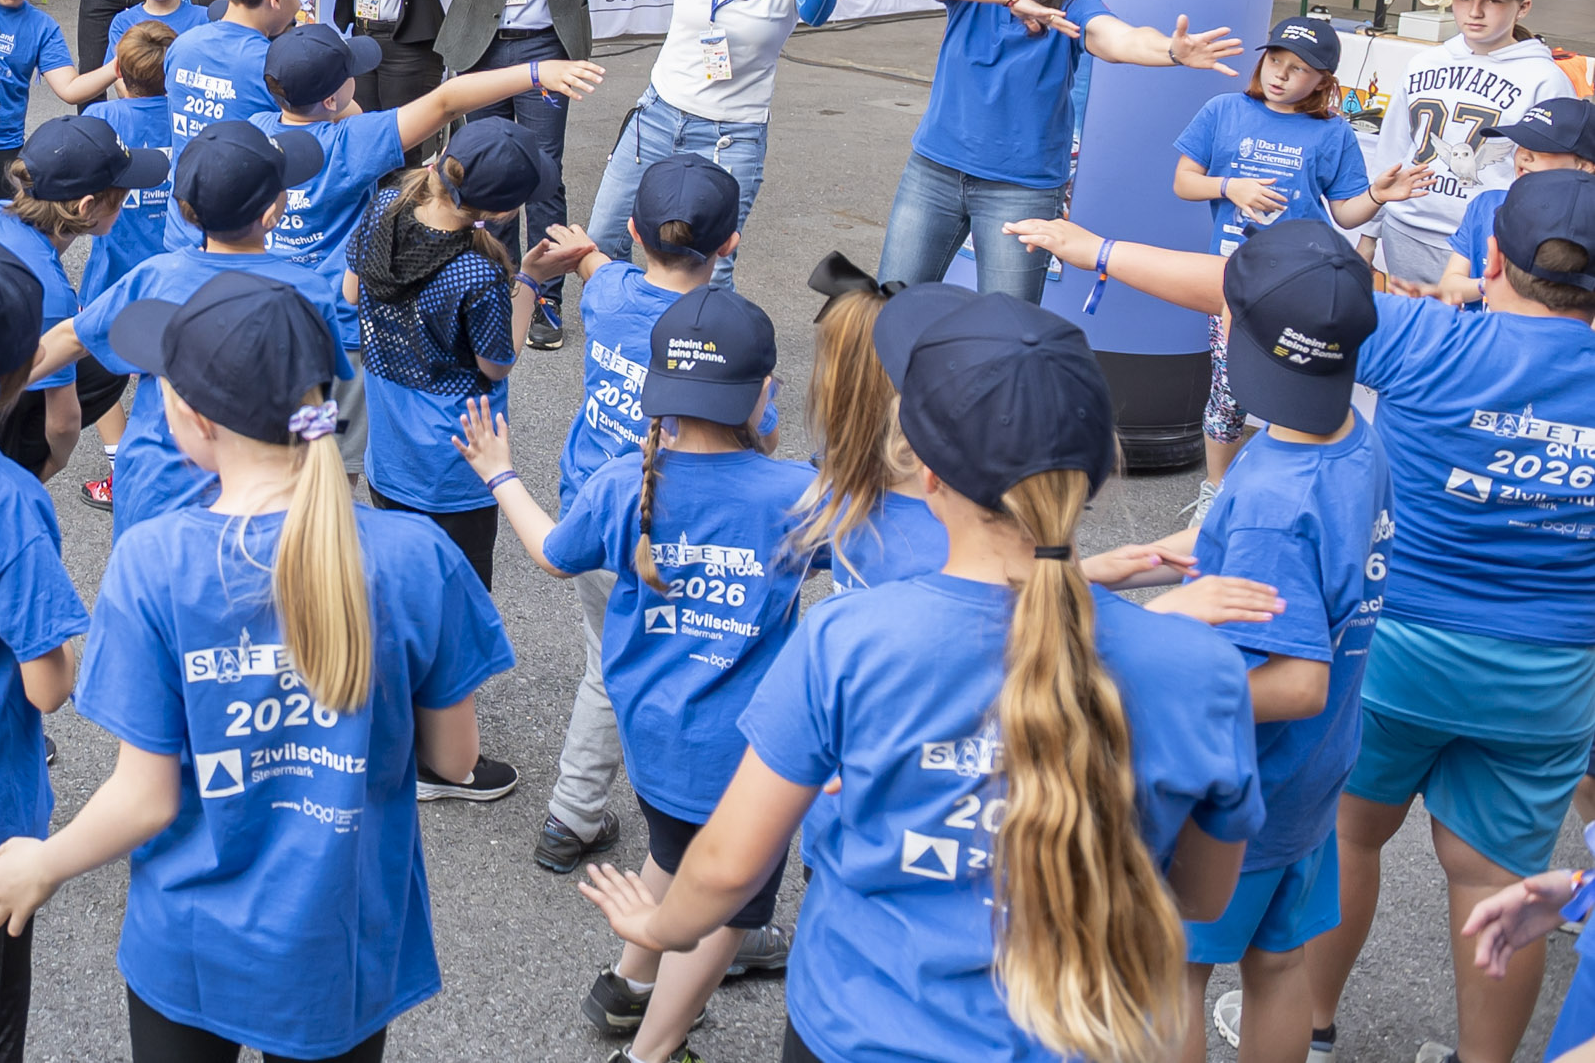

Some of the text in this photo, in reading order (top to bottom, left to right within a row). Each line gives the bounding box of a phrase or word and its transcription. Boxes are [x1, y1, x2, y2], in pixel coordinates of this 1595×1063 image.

[1408, 66, 1522, 110] HOGWARTS
[183, 95, 225, 120] 2026
[1253, 151, 1300, 168] Steiermark
[1258, 140, 1303, 156] Das Land
[142, 190, 170, 199] Zivilsc
[281, 214, 304, 230] 26
[668, 338, 717, 352] Scheint eh
[1277, 335, 1310, 355] keine
[1282, 326, 1341, 352] Scheint eh
[592, 342, 648, 382] SAFET
[667, 348, 727, 364] keine Sonne.
[594, 379, 644, 422] 2026
[598, 411, 647, 445] Zivilschu
[1475, 412, 1595, 444] SAFET
[1545, 442, 1574, 460] ON
[1487, 449, 1595, 489] 2026
[650, 543, 751, 566] SAFETY
[704, 561, 766, 578] ON TOUR
[666, 576, 747, 607] 2026
[680, 624, 724, 641] Steiermark
[681, 608, 761, 637] Zivilschutz
[191, 648, 296, 679] SAFE
[224, 692, 339, 737] 2026
[250, 742, 366, 774] Zivilschutz
[250, 765, 315, 784] Steiermark
[944, 792, 1011, 835] 20
